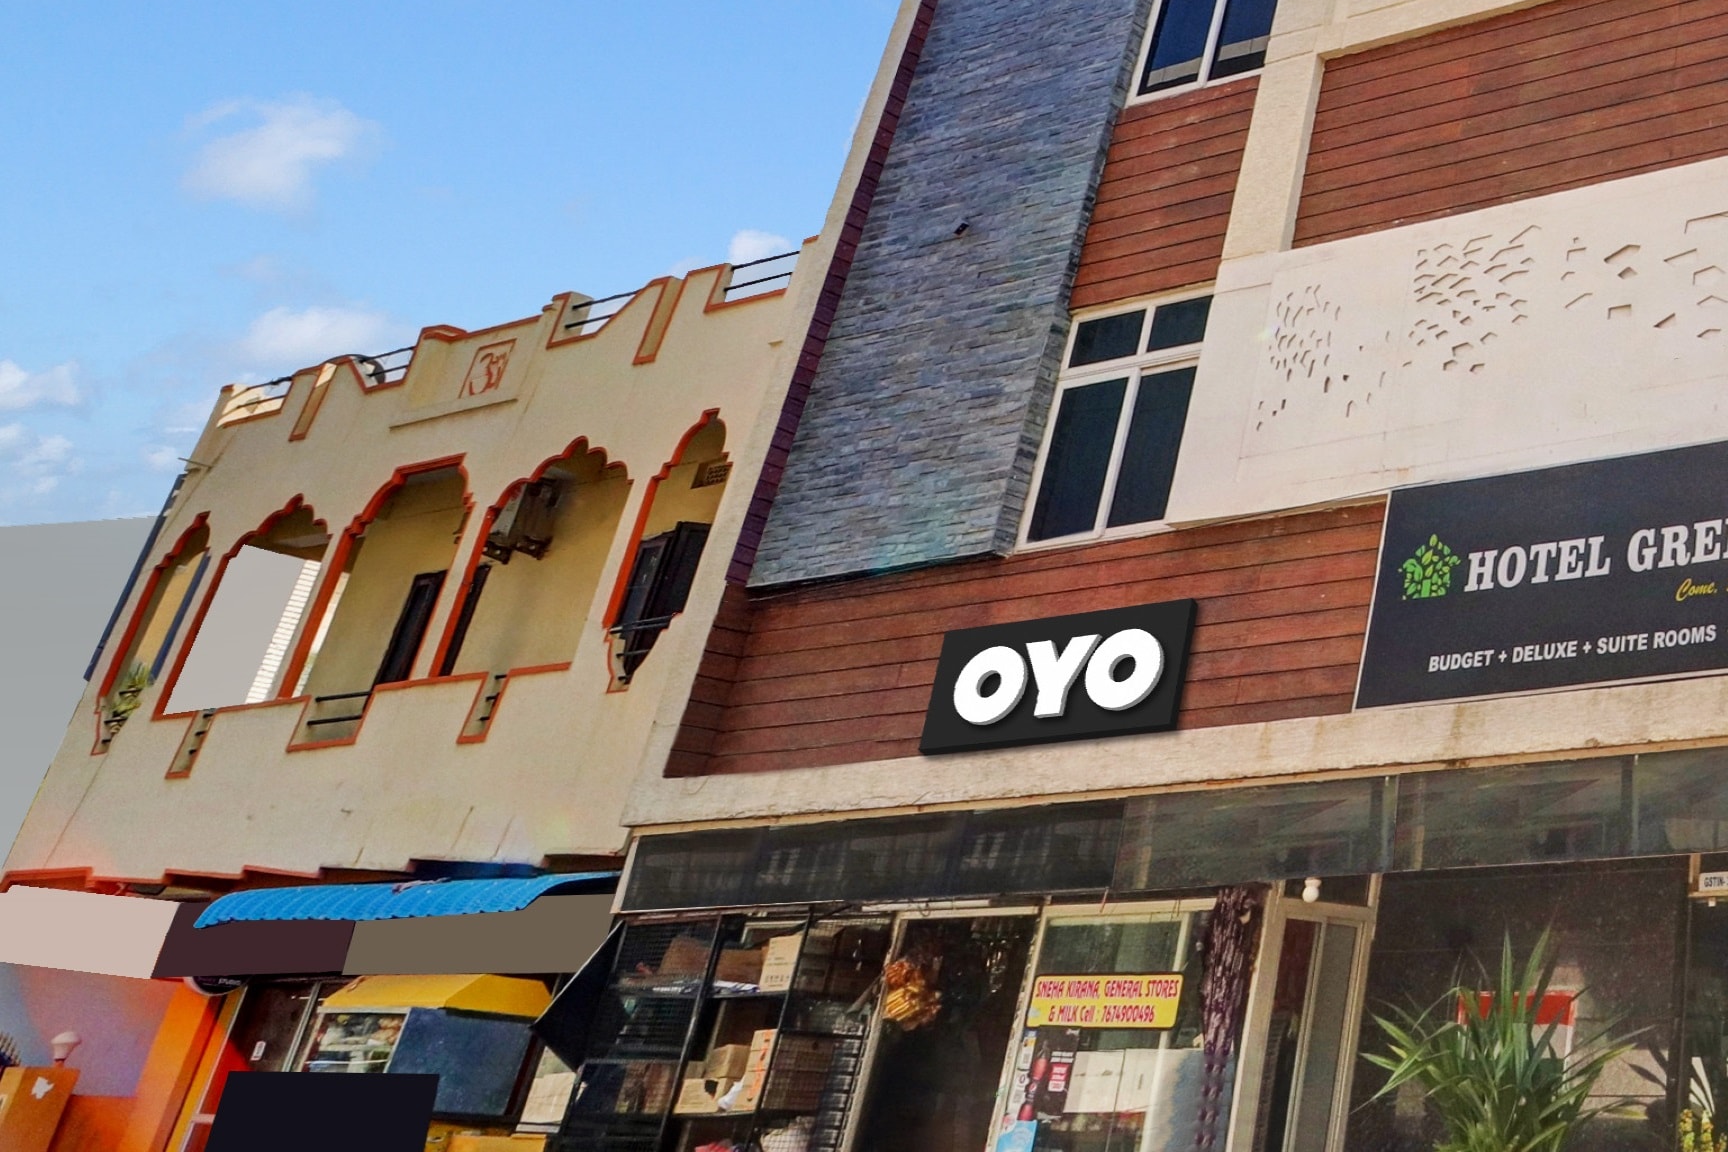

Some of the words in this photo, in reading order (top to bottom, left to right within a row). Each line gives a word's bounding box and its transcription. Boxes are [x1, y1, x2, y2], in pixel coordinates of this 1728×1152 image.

[1464, 535, 1612, 593] HOTEL
[1428, 649, 1494, 672] BUDGET
[1512, 640, 1578, 663] DELUXE
[1597, 633, 1649, 655] SUITE
[1652, 625, 1717, 649] ROOMS
[953, 628, 1165, 726] OYO
[1035, 981, 1064, 998] SNEHA
[1103, 980, 1144, 998] GENERAL
[1145, 979, 1180, 998] STORES
[1048, 1005, 1056, 1022] &
[1058, 1005, 1079, 1022] MILK
[1079, 1004, 1095, 1022] Cell
[1101, 1004, 1156, 1023] 7674900496
